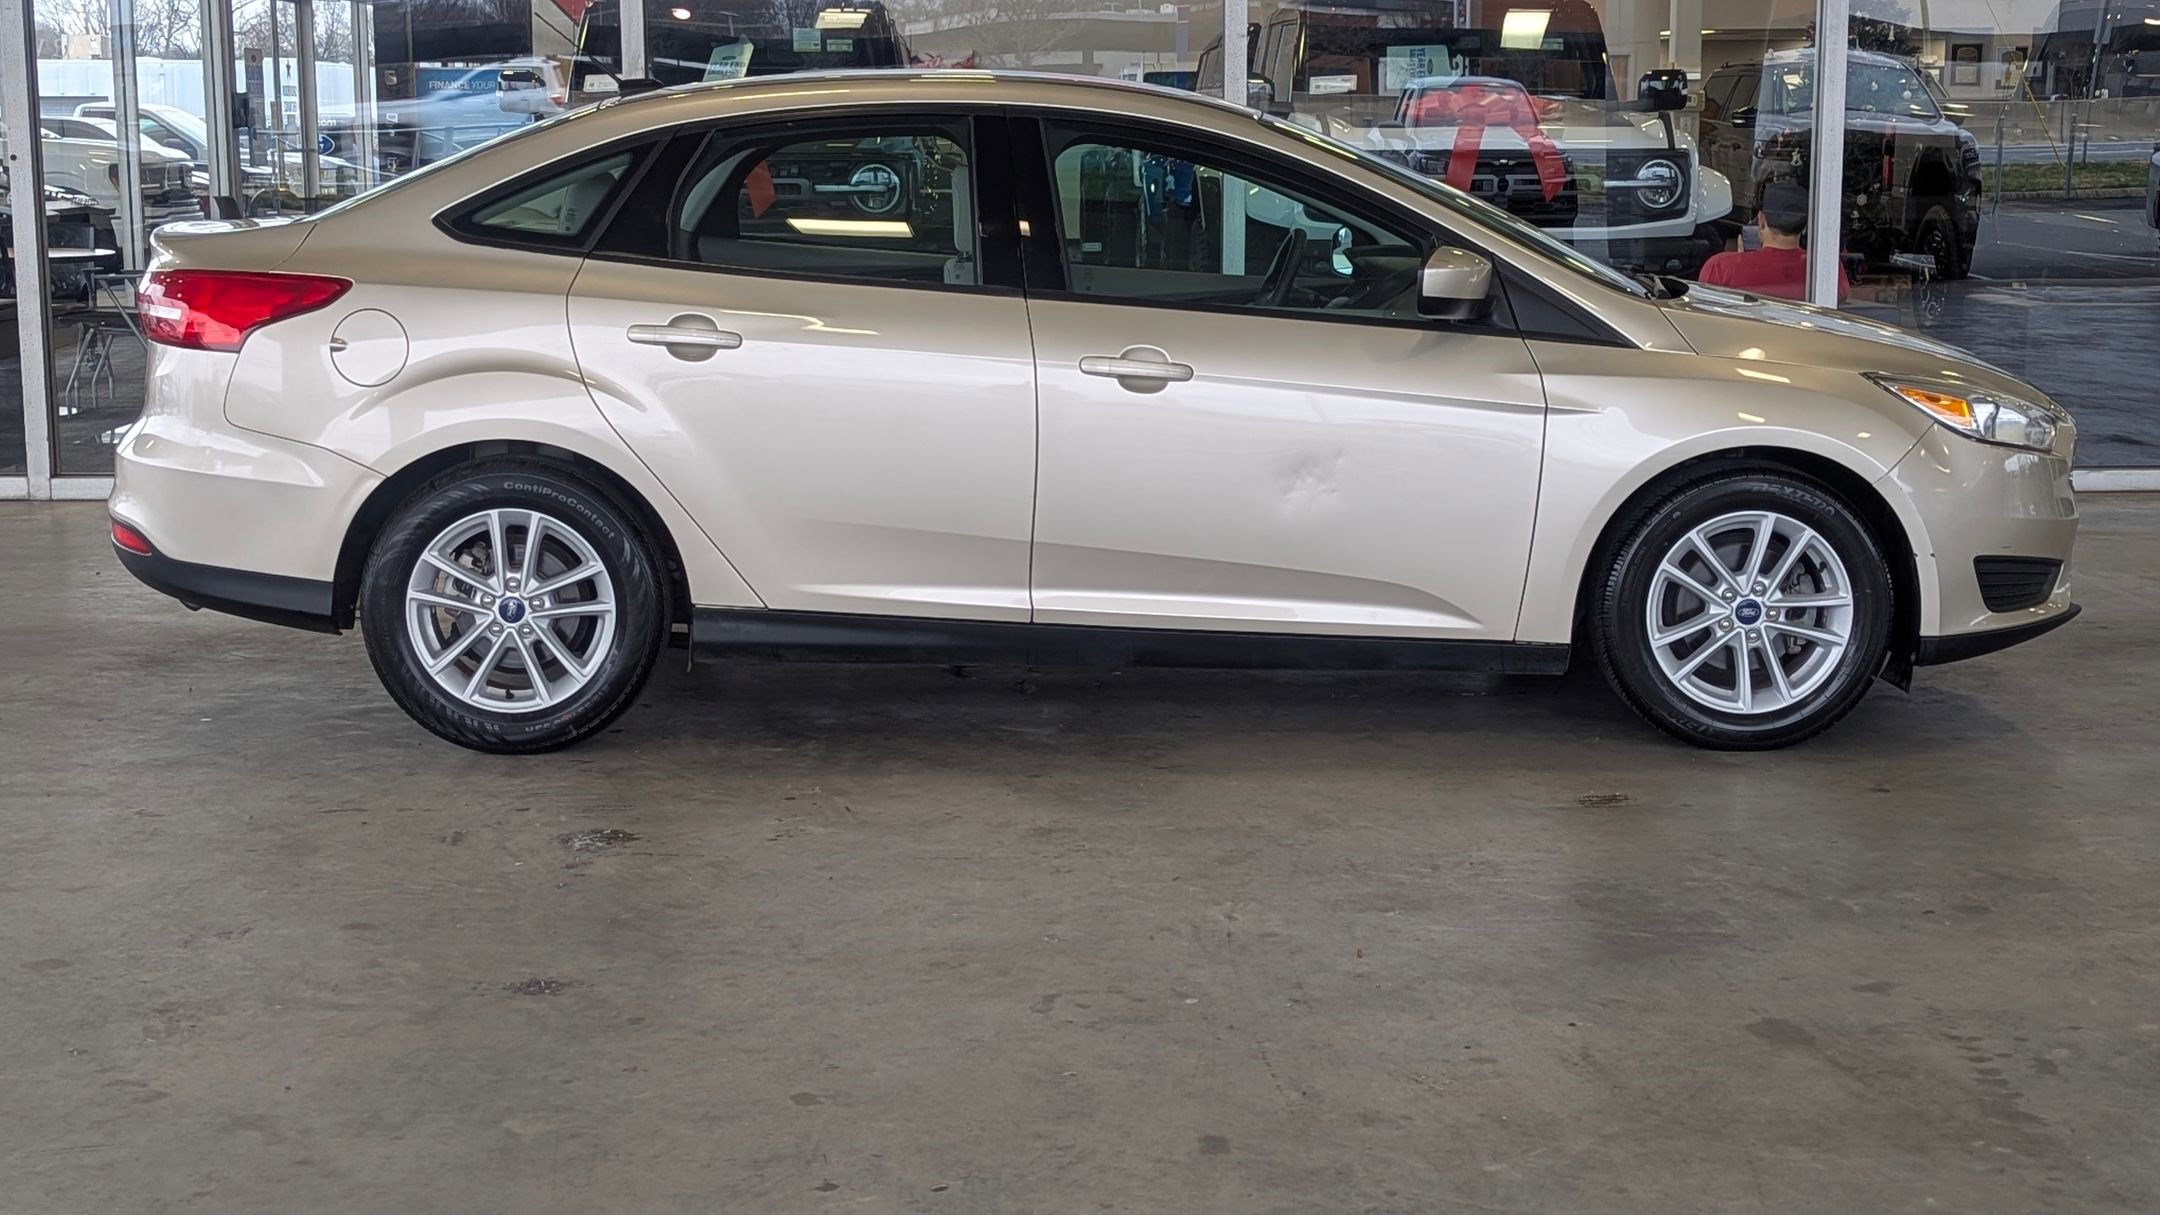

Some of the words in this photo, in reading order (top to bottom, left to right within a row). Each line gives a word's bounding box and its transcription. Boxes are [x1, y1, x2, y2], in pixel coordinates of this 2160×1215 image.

[428, 80, 470, 89] FINANCE
[471, 80, 496, 90] YOUR
[503, 481, 615, 540] ContiProContact
